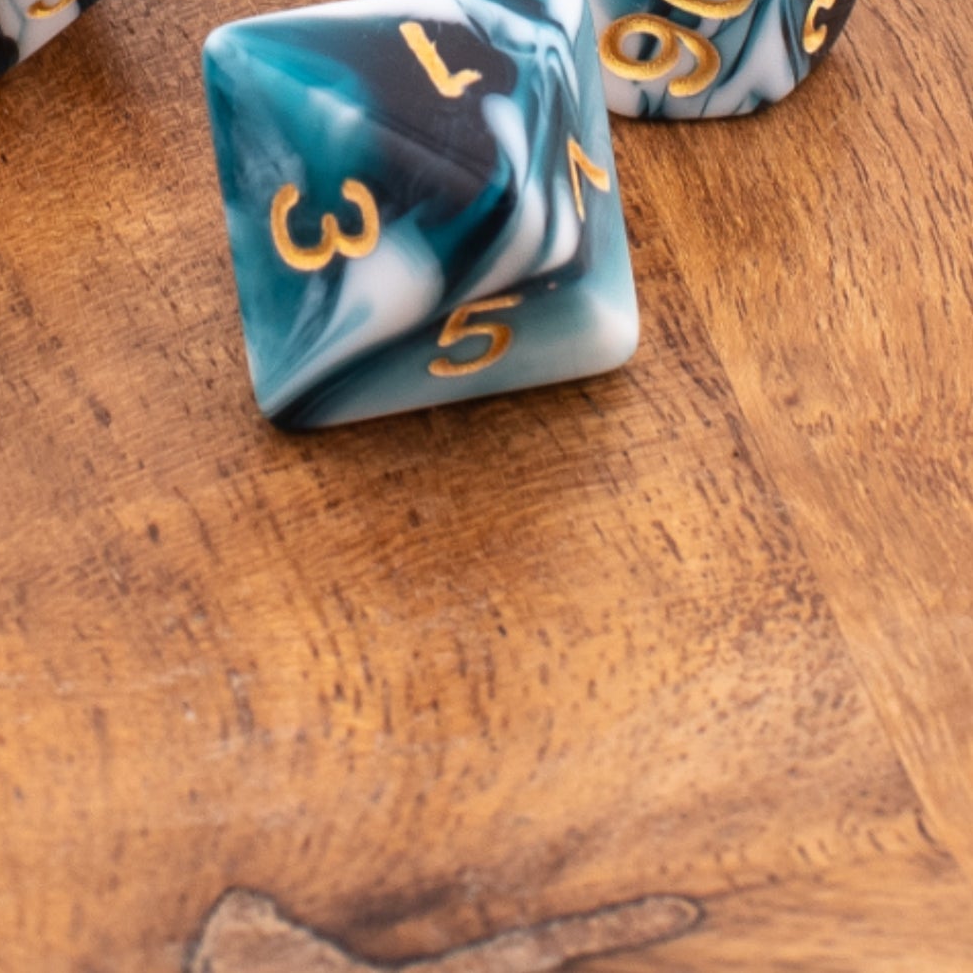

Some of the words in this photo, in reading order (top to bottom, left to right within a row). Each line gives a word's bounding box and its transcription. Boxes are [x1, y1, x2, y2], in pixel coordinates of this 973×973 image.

[399, 21, 482, 98] 1
[270, 178, 380, 272] 3
[428, 293, 524, 377] 5
